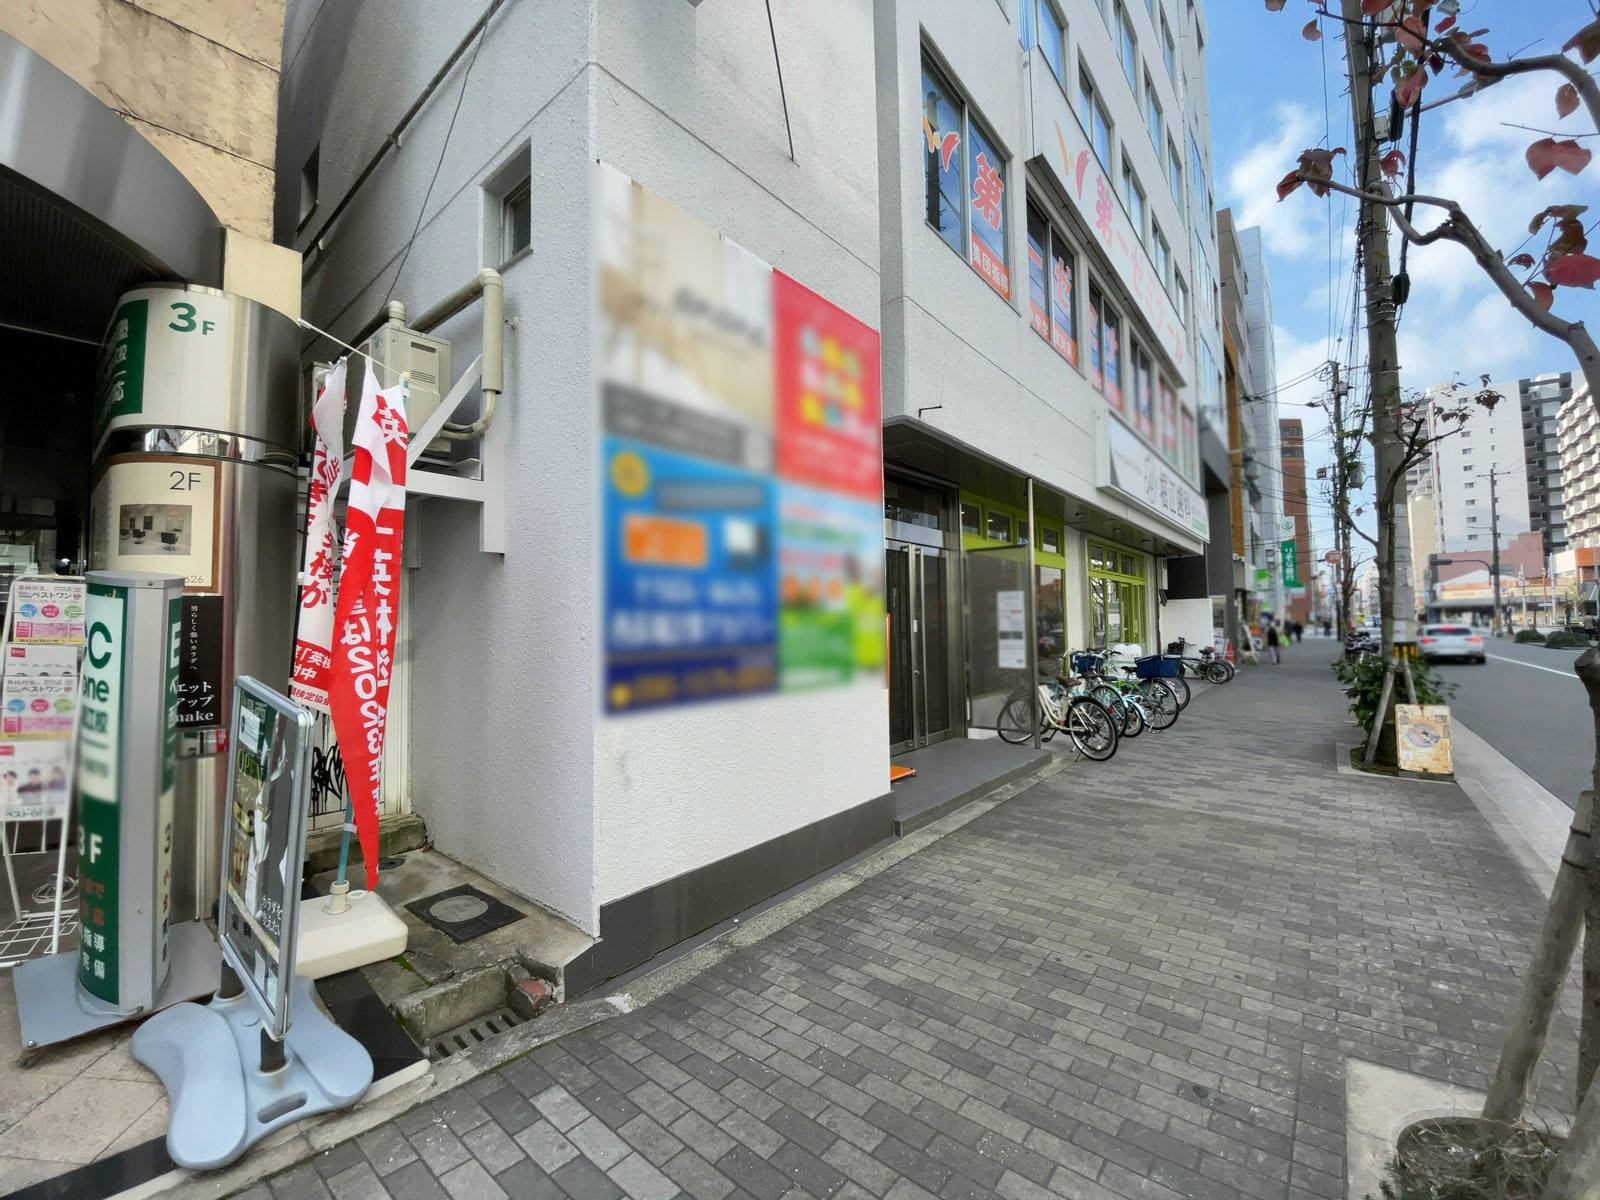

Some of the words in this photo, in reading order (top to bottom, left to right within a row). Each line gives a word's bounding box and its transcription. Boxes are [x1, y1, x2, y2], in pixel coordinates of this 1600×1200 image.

[972, 152, 1005, 231] 第
[168, 302, 216, 336] 3F
[169, 470, 202, 491] 2F
